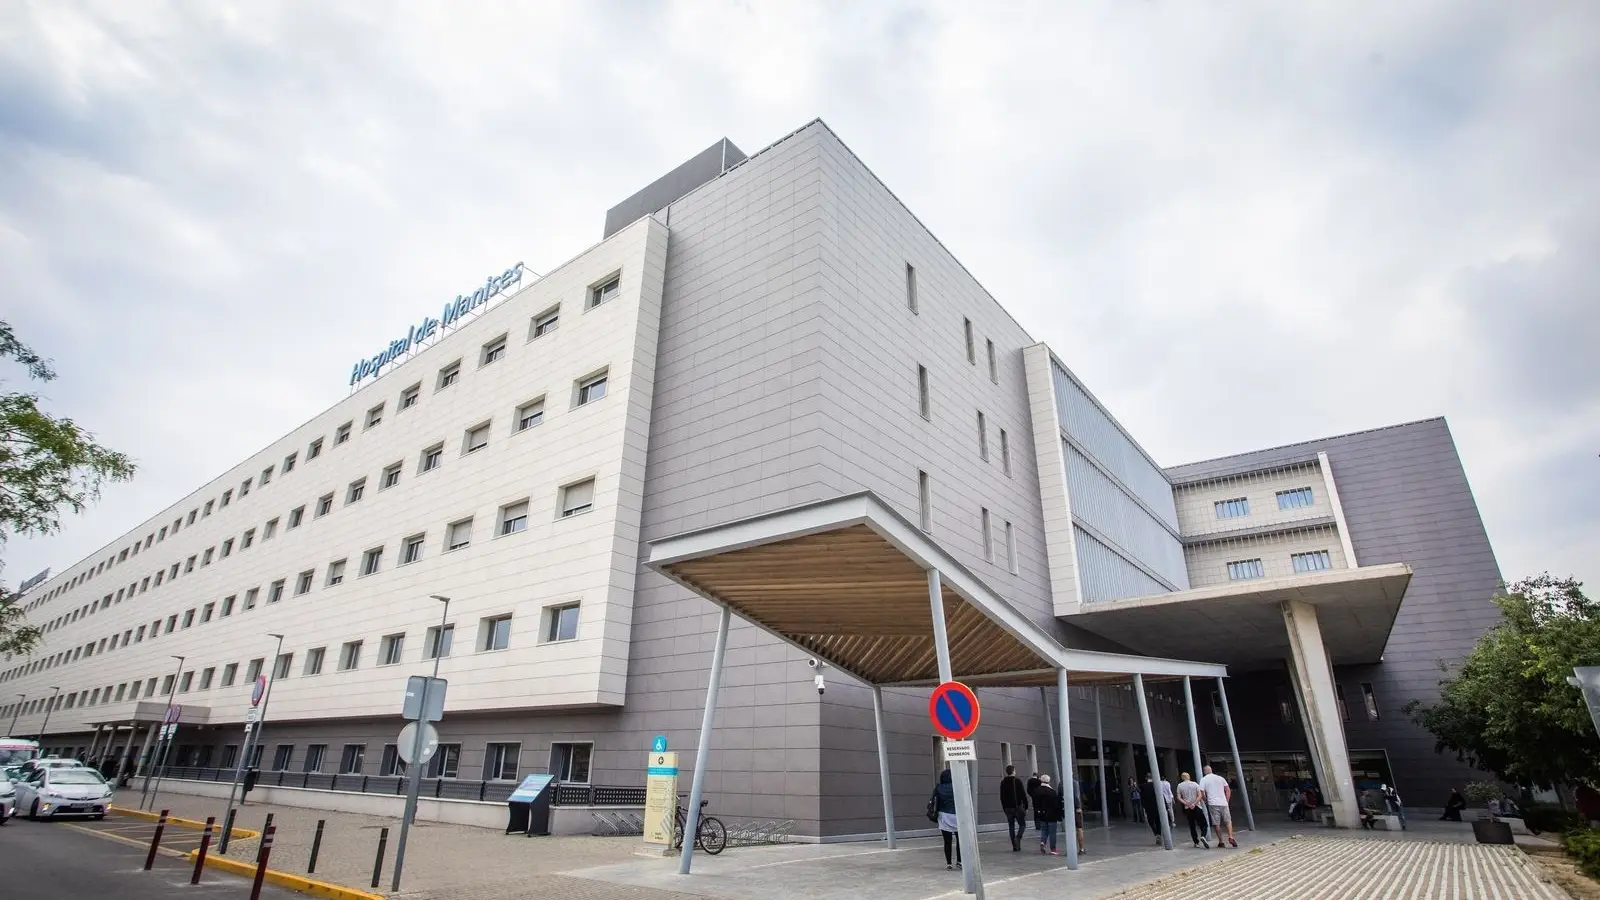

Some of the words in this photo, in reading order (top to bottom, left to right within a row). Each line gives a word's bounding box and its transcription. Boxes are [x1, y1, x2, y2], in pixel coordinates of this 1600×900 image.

[349, 325, 415, 386] Hospital
[414, 316, 439, 345] de
[441, 261, 524, 328] Manises
